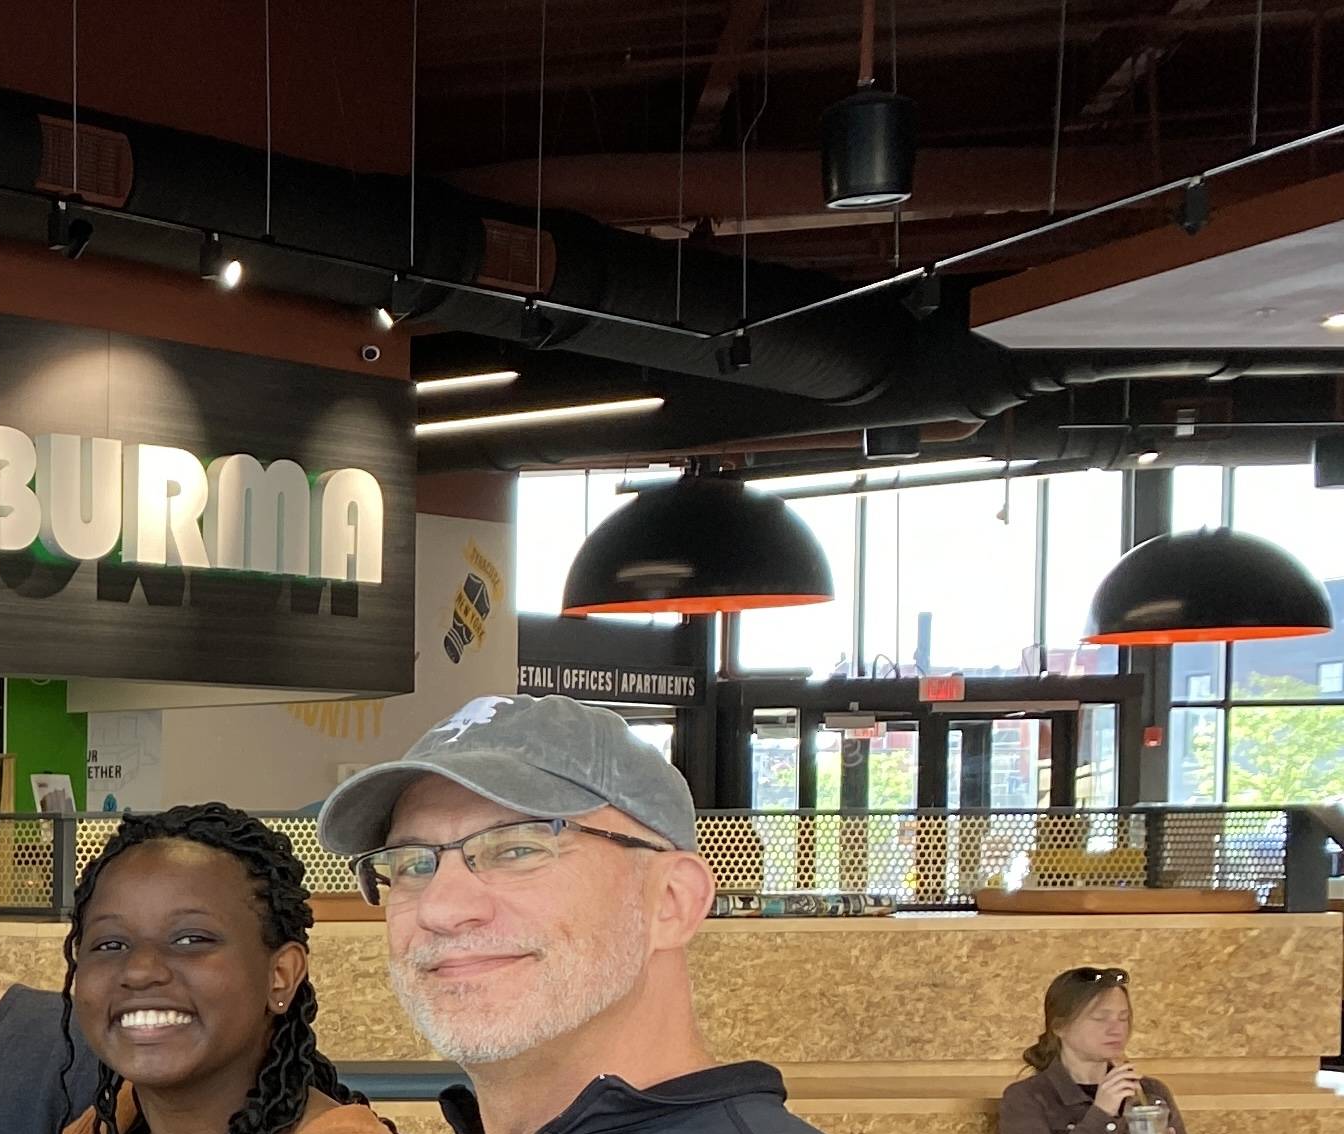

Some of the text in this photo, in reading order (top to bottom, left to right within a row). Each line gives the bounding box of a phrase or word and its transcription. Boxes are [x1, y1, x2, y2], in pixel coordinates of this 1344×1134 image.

[519, 665, 695, 697] ETAIL OFFICES APARTMENTS
[87, 765, 122, 779] ETHER
